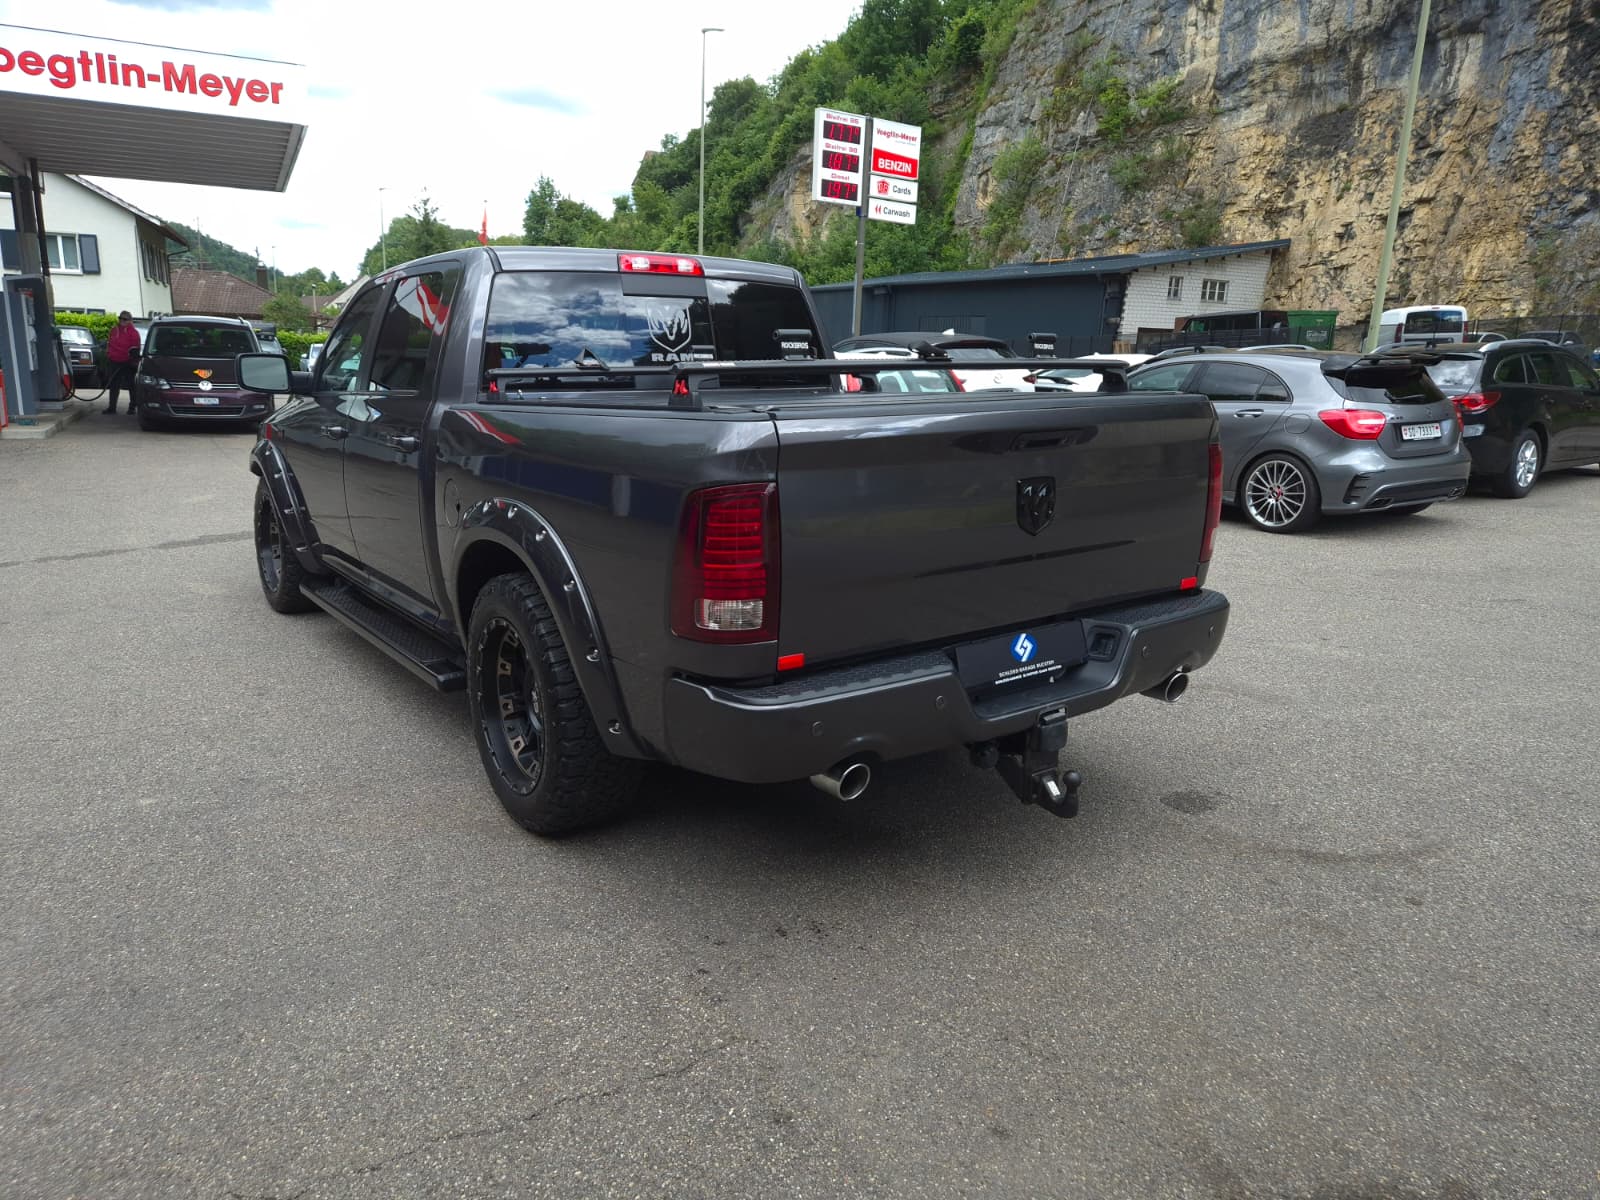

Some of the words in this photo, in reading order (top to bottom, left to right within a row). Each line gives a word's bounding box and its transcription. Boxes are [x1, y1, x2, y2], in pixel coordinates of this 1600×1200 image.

[876, 128, 917, 142] Voegtlin-Meyer
[878, 158, 912, 173] BENZIN
[892, 185, 911, 195] Cards
[883, 207, 911, 218] Carwash
[651, 353, 695, 362] RAM
